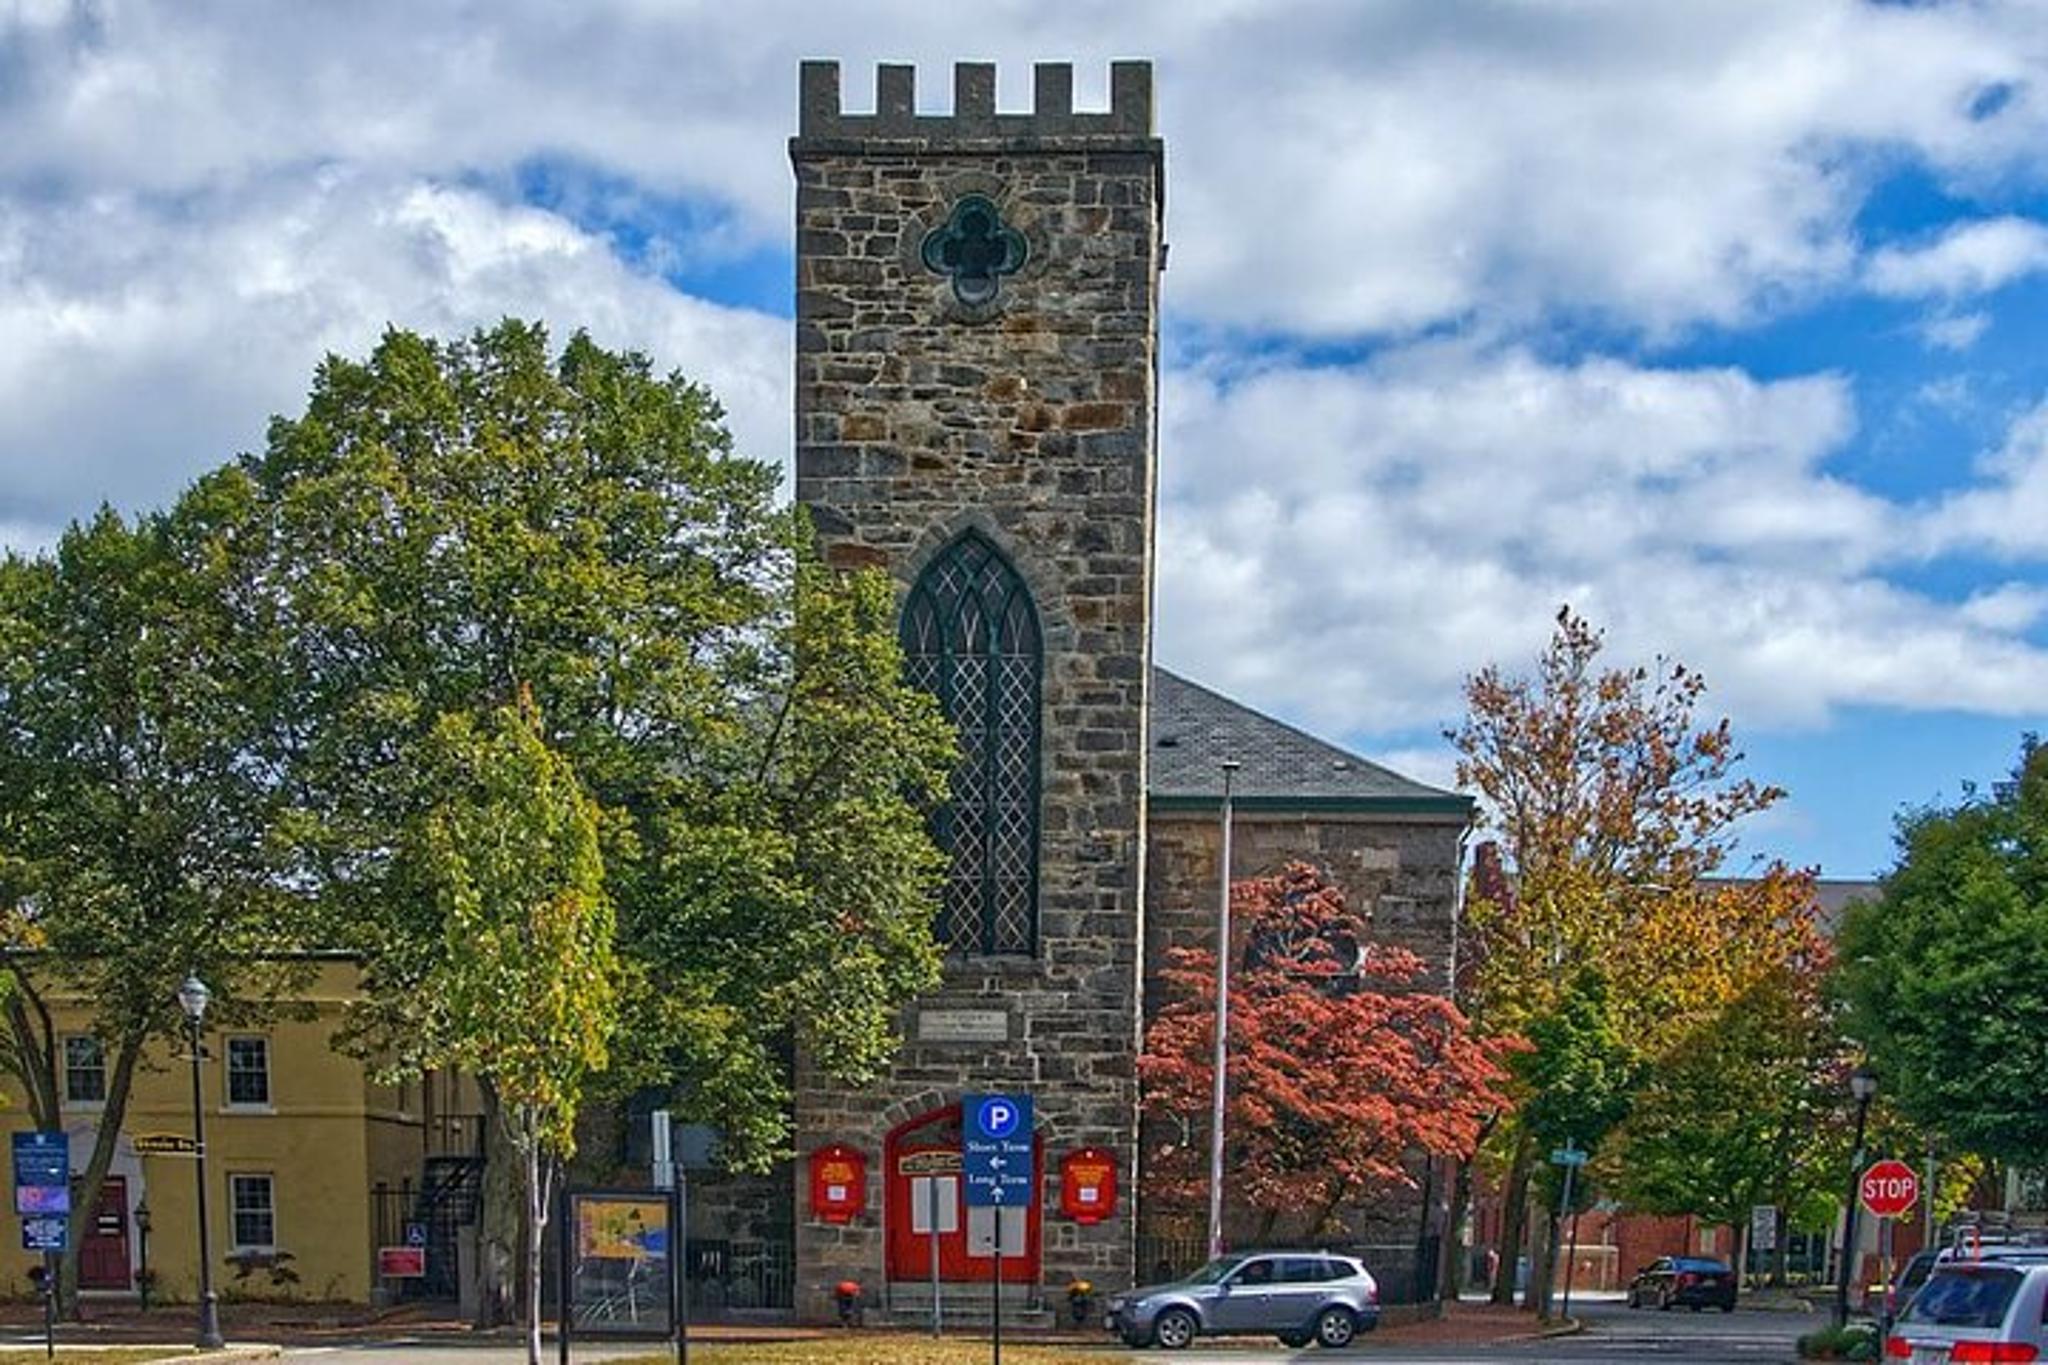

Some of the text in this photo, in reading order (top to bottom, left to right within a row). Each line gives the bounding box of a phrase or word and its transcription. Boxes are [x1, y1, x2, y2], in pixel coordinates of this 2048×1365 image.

[991, 1105, 1010, 1130] P
[1001, 1140, 1030, 1153] Term
[969, 1174, 1028, 1186] Long Term
[1864, 1177, 1913, 1199] STOP
